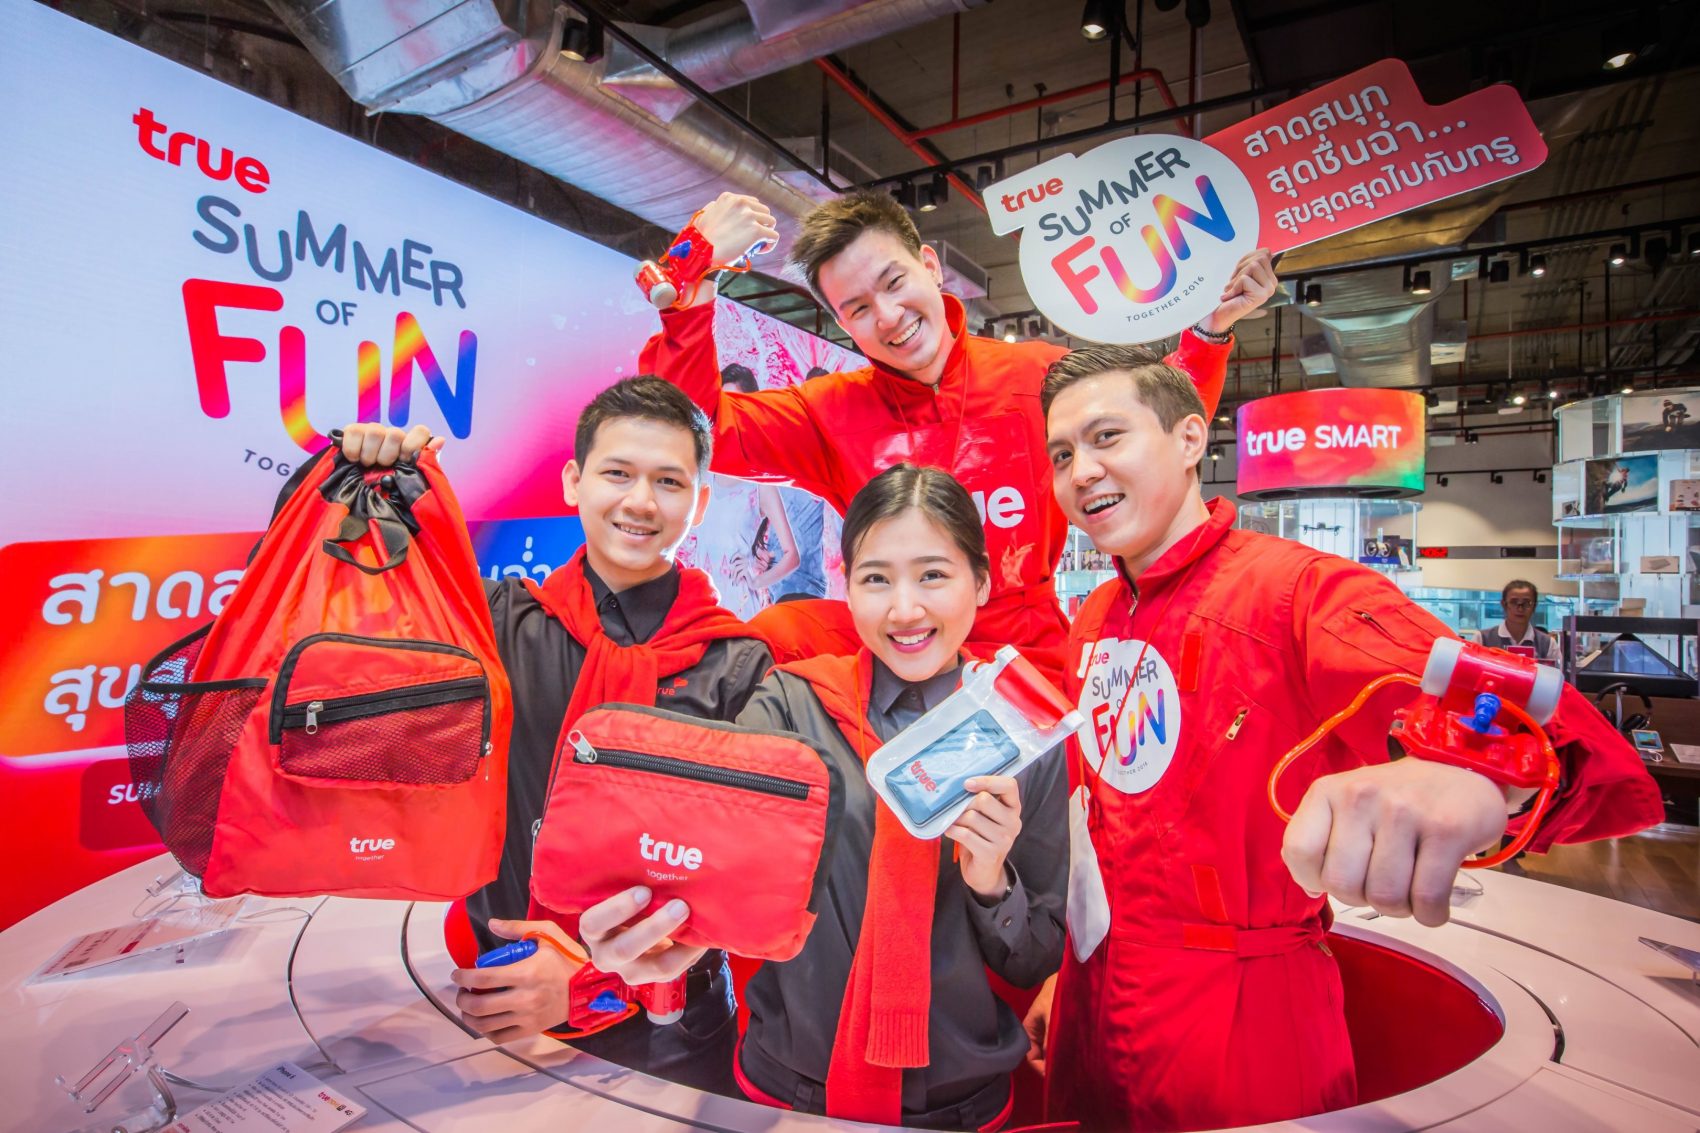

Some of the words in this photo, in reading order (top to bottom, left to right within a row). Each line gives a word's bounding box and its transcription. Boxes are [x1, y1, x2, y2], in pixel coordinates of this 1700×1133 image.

[1243, 85, 1390, 157] สาดสนุก
[132, 107, 270, 193] true
[1001, 178, 1064, 212] true
[1038, 146, 1190, 241] SUMMER
[1274, 136, 1521, 233] สุขสุดสุดไปกับทรู
[1051, 174, 1235, 315] FUN
[1109, 212, 1131, 235] OF
[193, 195, 467, 309] SUMMER
[316, 300, 357, 326] OF
[1126, 296, 1181, 322] TOGETHER
[1182, 276, 1204, 296] 2016
[182, 278, 478, 455] FUN
[1246, 427, 1306, 456] true
[1314, 425, 1402, 449] SMART
[244, 449, 291, 477] TOG
[1092, 657, 1159, 700] SUMMER
[1091, 688, 1167, 767] FUN
[910, 760, 937, 792] true
[349, 836, 396, 853] true
[639, 832, 703, 870] true
[646, 868, 688, 881] together
